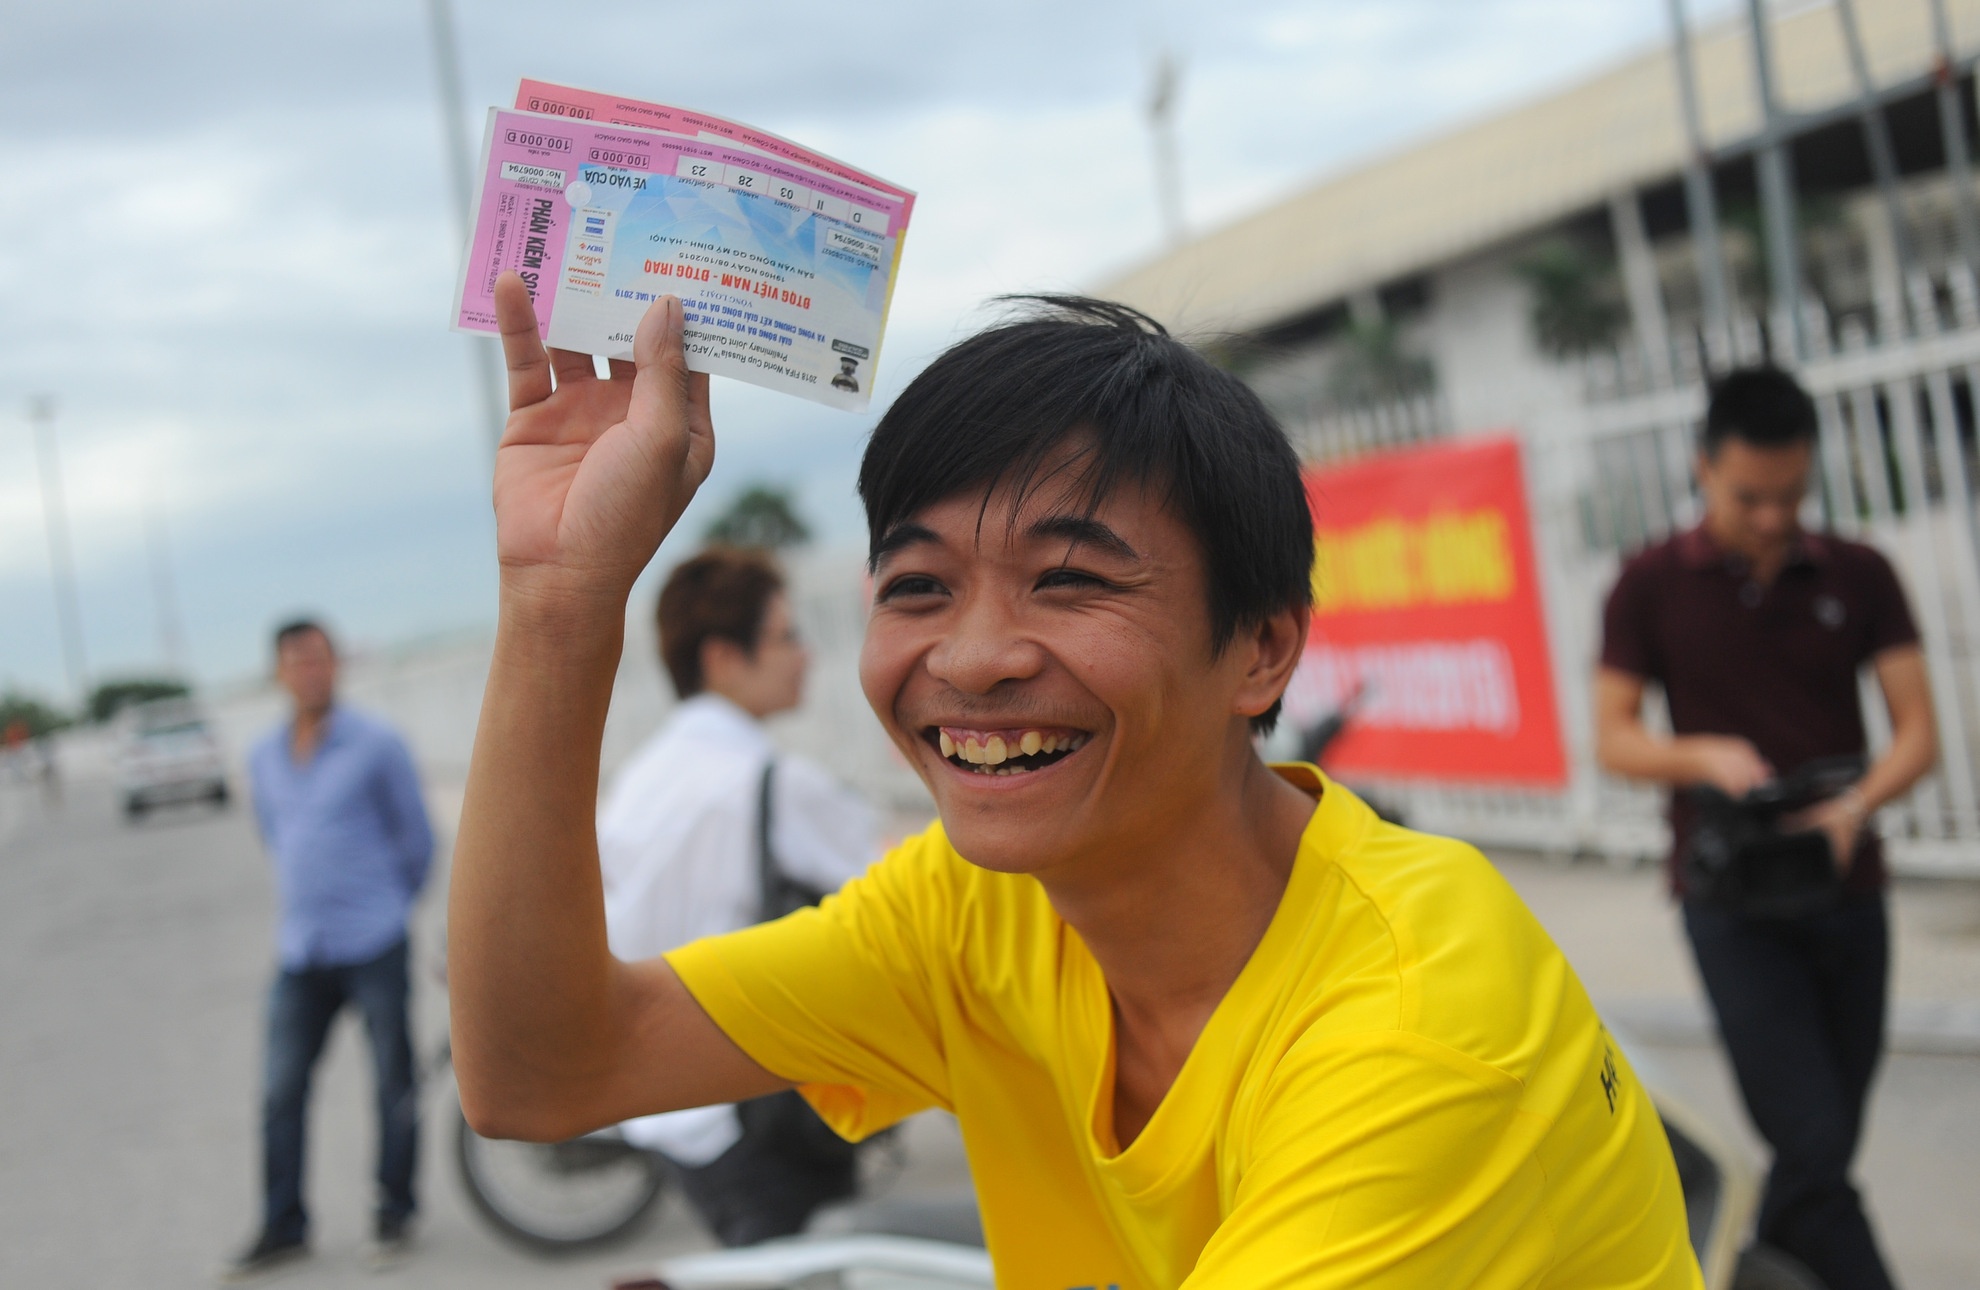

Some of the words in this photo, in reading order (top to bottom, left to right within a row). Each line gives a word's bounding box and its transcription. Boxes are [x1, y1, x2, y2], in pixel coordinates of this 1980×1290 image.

[542, 102, 590, 120] 100.000
[519, 133, 569, 150] 100.000
[616, 136, 632, 144] GIAO
[602, 151, 647, 166] 100.000
[509, 164, 544, 177] 0006794
[691, 165, 707, 177] 23
[584, 170, 607, 184] CỬA
[608, 174, 631, 188] VÀO
[738, 175, 753, 187] 28
[632, 177, 647, 190] VÉ
[780, 187, 794, 200] 03
[529, 198, 555, 234] PHẦN
[852, 212, 862, 223] D
[649, 234, 667, 243] NỘI
[668, 237, 683, 245] HÀ
[522, 236, 550, 269] KIỂM
[586, 244, 604, 253] BIDV
[732, 249, 747, 258] QG
[679, 252, 729, 267] 08/10/2015
[644, 259, 673, 276] IRAQ
[676, 265, 710, 282] ĐTQG
[730, 262, 758, 274] NGÀY
[797, 268, 814, 279] SÂN
[721, 273, 751, 291] NAM
[759, 270, 785, 282] 19H00
[519, 271, 541, 305] SOÁ
[614, 288, 634, 299] 2019
[699, 289, 705, 297] 2
[753, 282, 778, 300] VIỆT
[635, 291, 649, 301] UAE
[781, 290, 810, 309] ĐTQG
[721, 306, 742, 318] BÓNG
[700, 315, 715, 325] THẾ
[716, 318, 735, 329] ĐỊCH
[759, 316, 773, 327] KẾT
[736, 323, 746, 332] VÔ
[747, 326, 757, 336] ĐÁ
[774, 320, 797, 333] CHUNG
[682, 328, 727, 345] Qualificatio
[758, 329, 778, 341] BÓNG
[728, 338, 748, 350] Joint
[748, 342, 788, 362] Preliminary
[747, 355, 762, 368] Cup
[763, 361, 783, 374] World
[785, 367, 800, 379] FIFA
[801, 372, 817, 384] 2018
